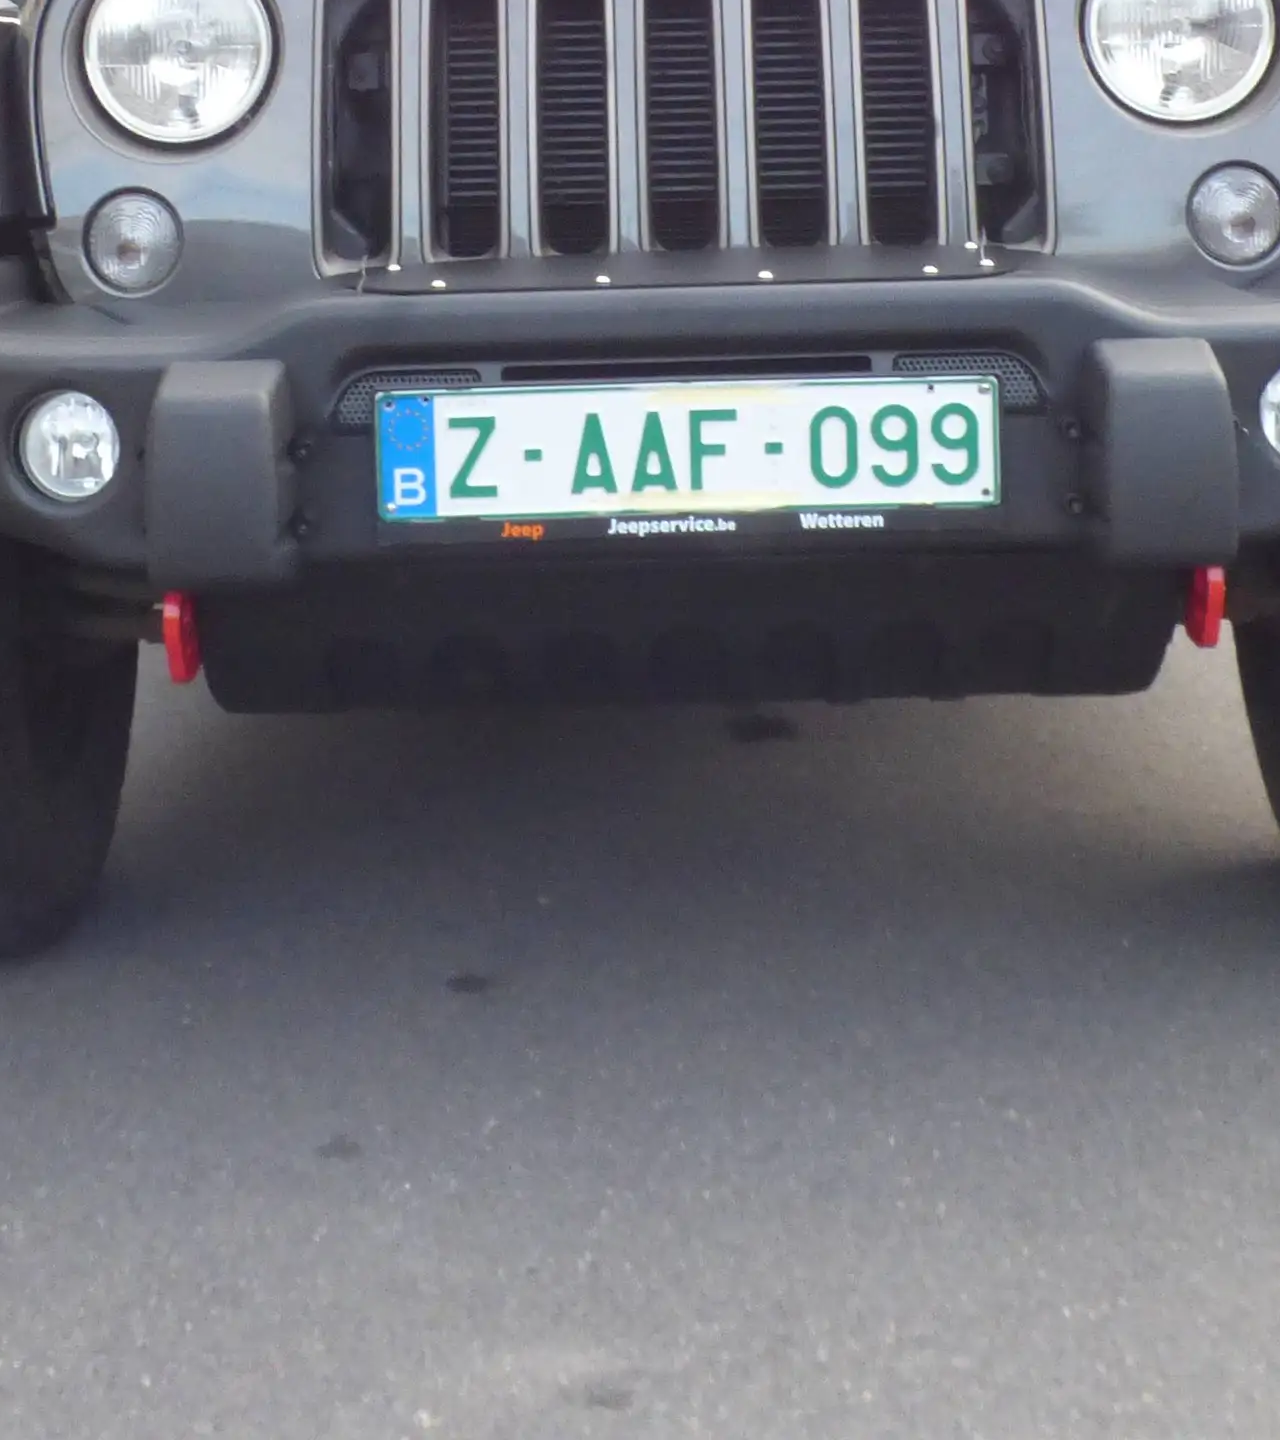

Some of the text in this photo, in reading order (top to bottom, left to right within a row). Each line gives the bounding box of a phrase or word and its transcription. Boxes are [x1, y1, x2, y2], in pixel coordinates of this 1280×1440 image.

[393, 467, 428, 508] B
[501, 511, 884, 540] Jeep Jeepservice.be Wetteren
